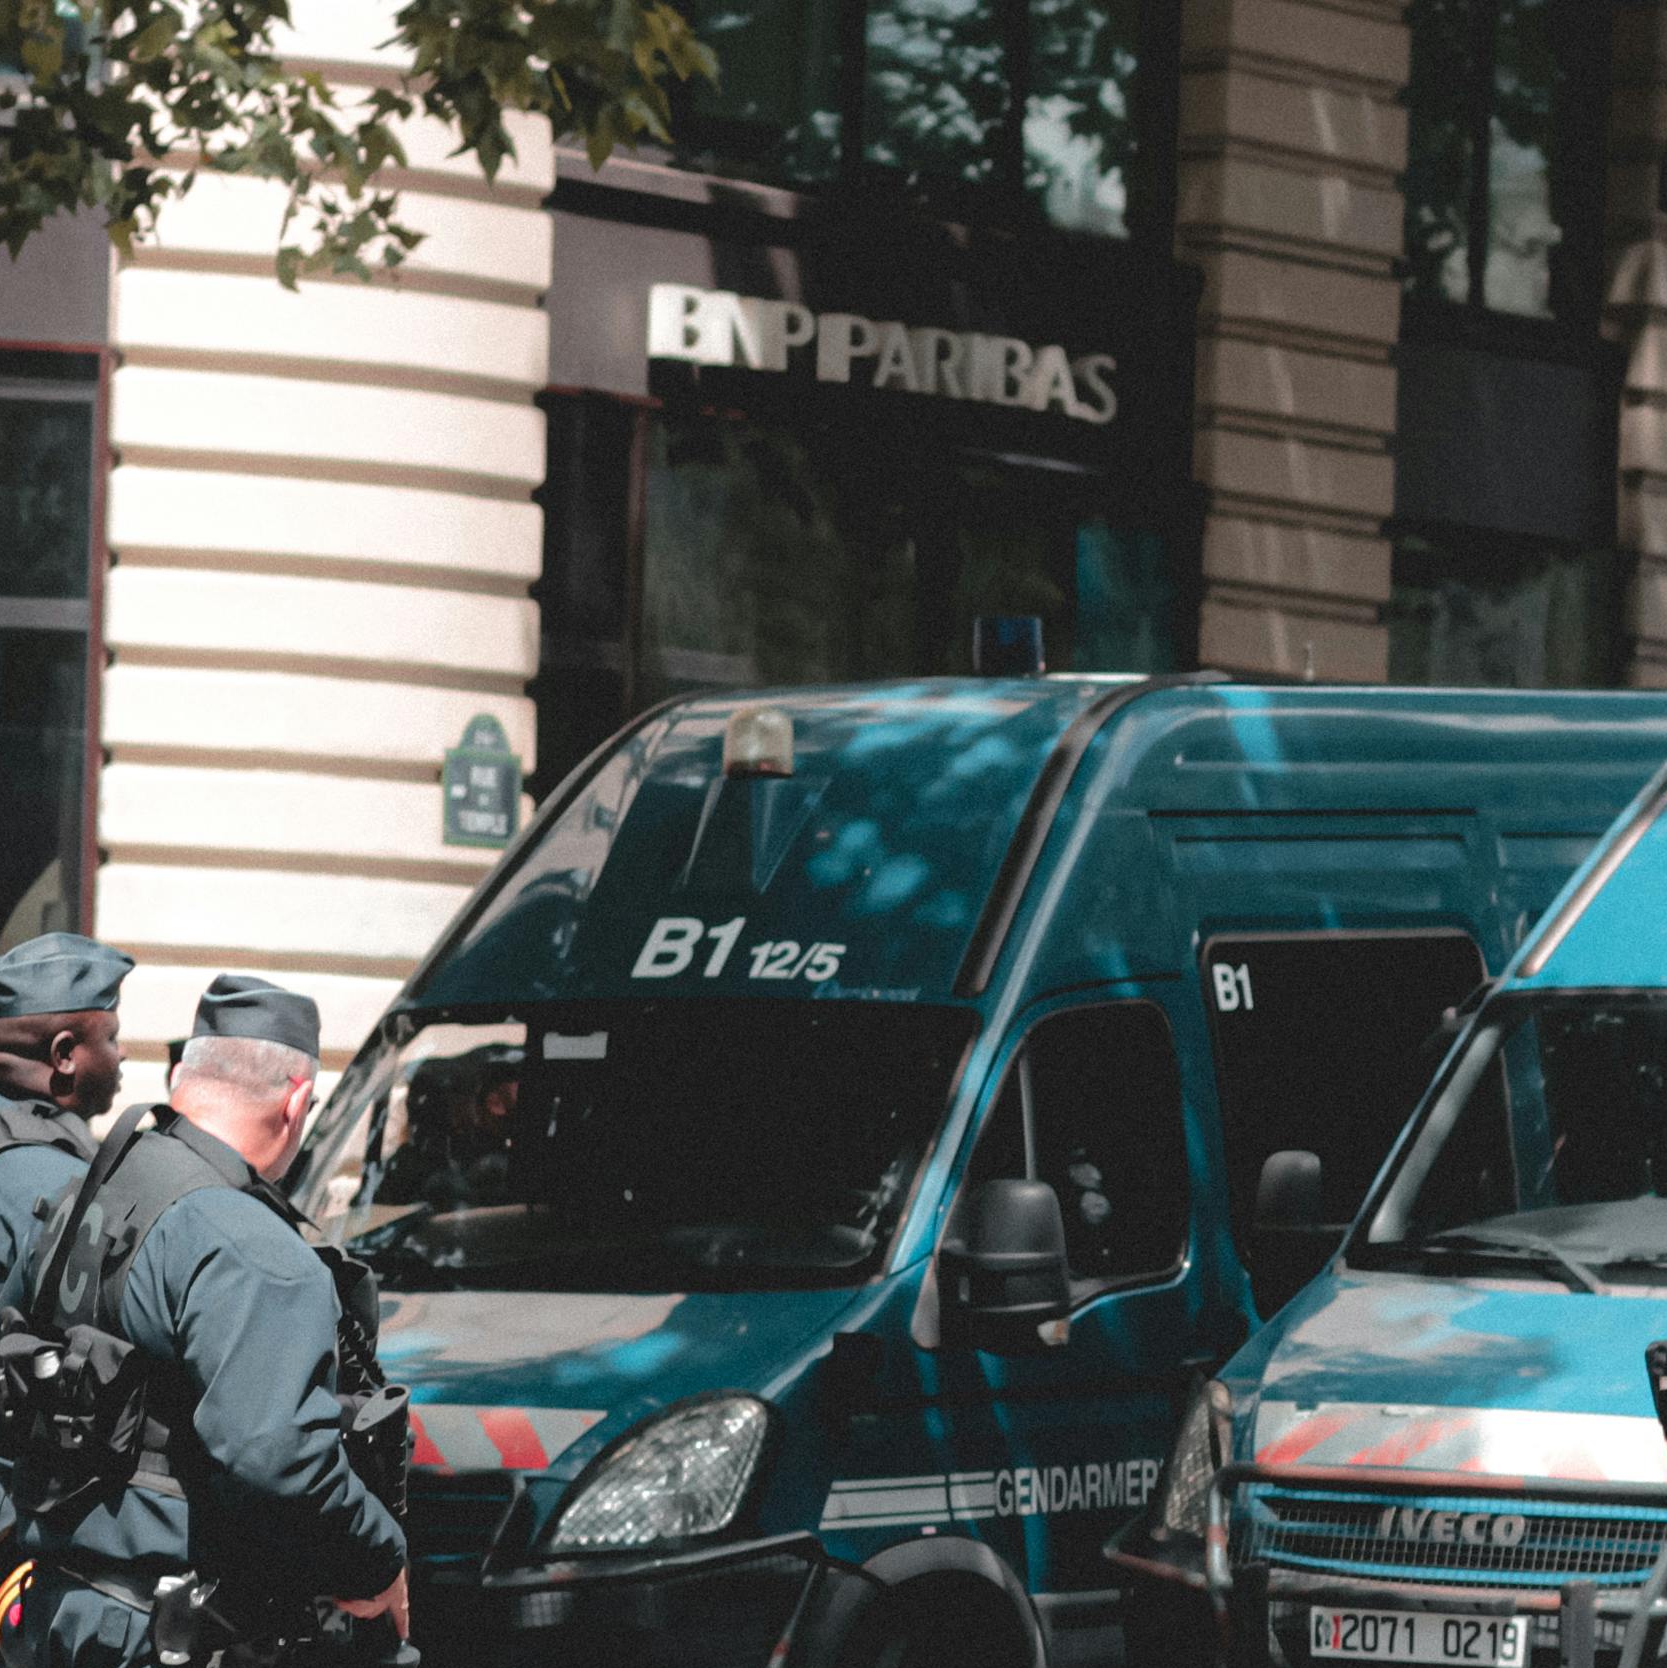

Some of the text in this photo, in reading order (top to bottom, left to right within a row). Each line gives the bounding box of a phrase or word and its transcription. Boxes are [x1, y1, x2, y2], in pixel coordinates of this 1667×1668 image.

[648, 283, 1117, 423] BNP PARIBAS
[630, 916, 847, 982] B1 12/5
[1212, 963, 1254, 1011] B1
[995, 1458, 1164, 1517] GENDARMER
[1378, 1506, 1526, 1546] IVECO
[1341, 1613, 1519, 1661] 2071 0219
